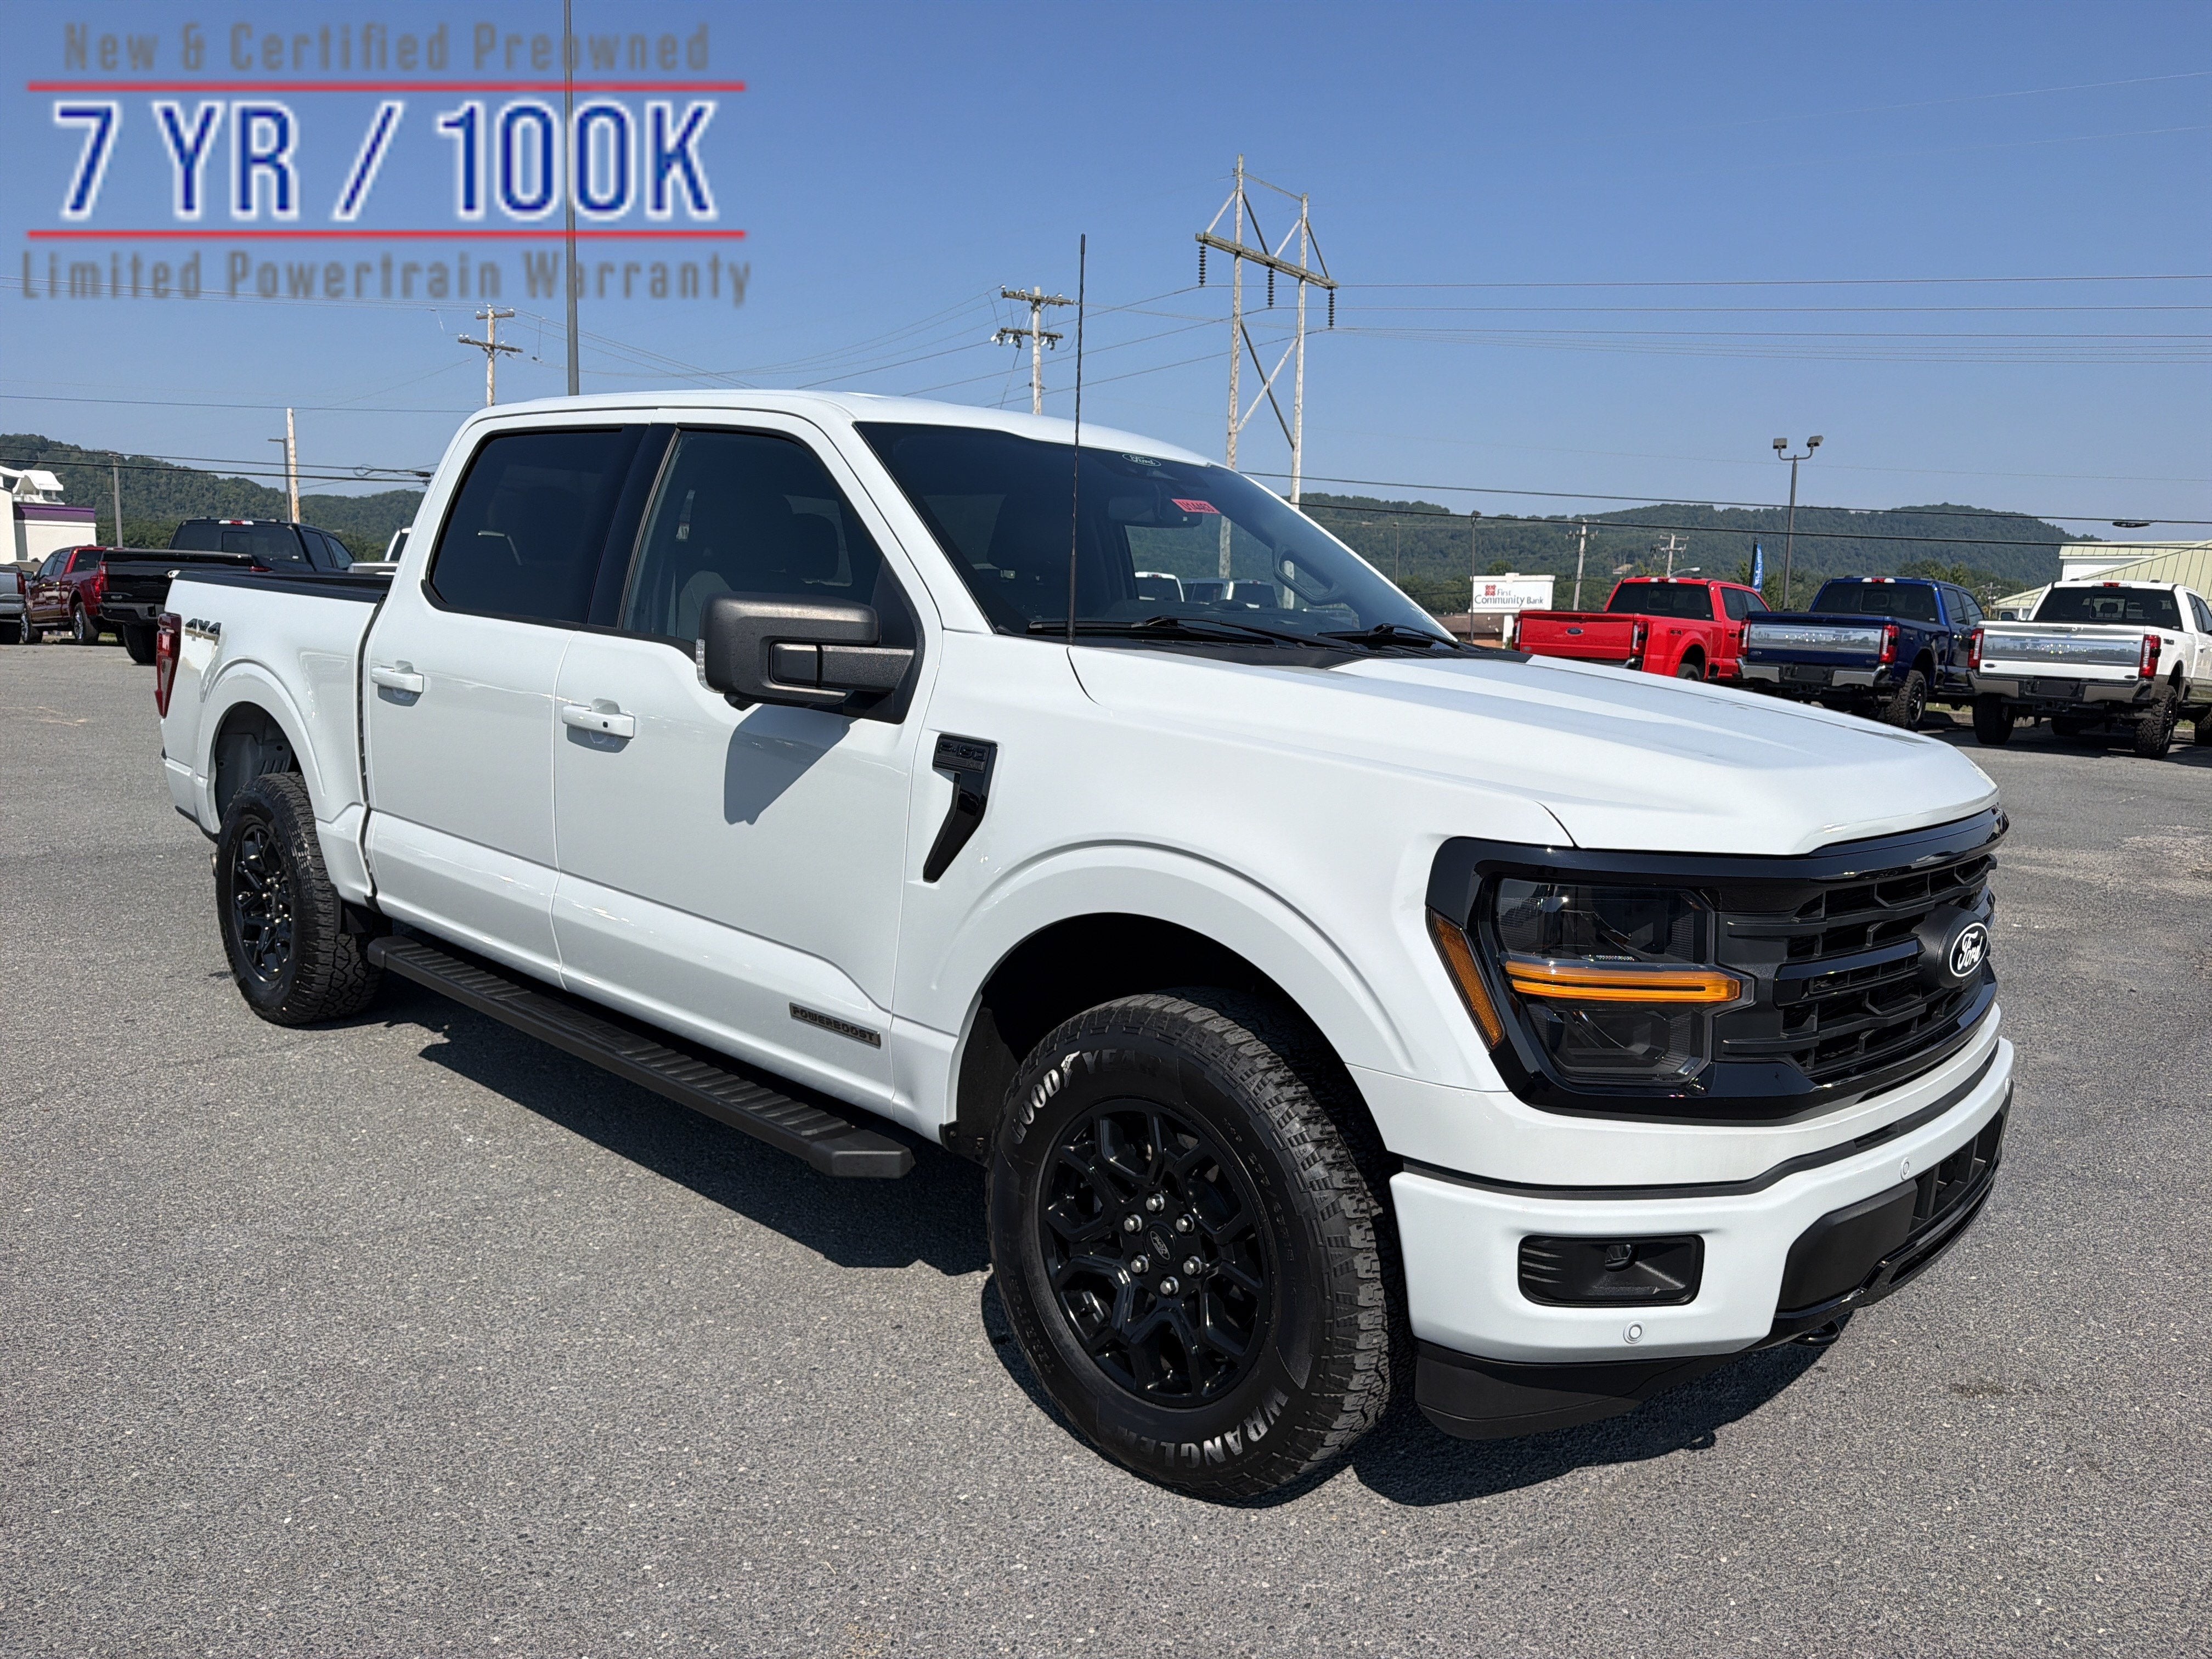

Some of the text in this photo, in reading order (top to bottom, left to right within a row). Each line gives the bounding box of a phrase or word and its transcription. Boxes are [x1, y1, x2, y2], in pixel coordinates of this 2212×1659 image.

[1497, 588, 1511, 596] First
[1474, 594, 1544, 607] Community Bank
[1957, 930, 1983, 970] Ford
